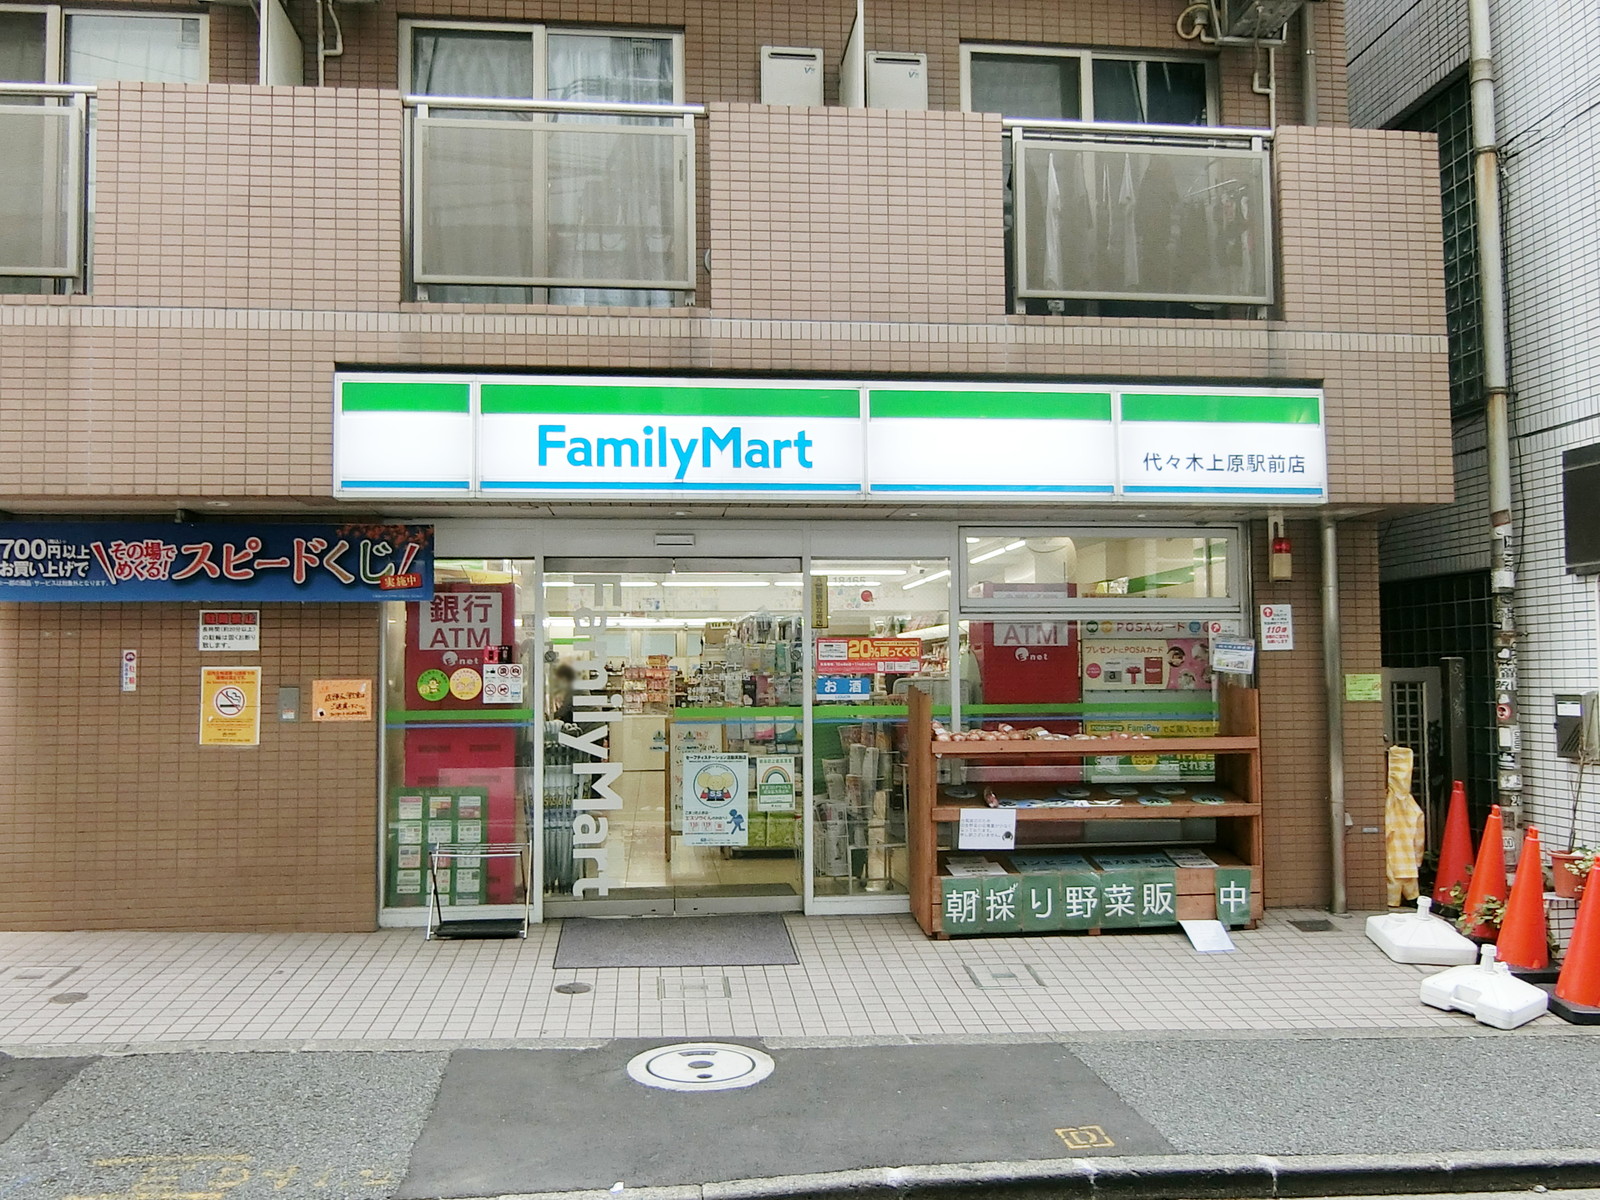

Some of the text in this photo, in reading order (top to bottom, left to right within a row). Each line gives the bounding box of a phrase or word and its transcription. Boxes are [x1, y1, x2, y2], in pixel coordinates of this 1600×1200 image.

[538, 424, 813, 480] FamilyMart
[1143, 451, 1306, 474] 代々木上原駅前店
[109, 540, 177, 561] その場で
[0, 560, 90, 578] お買い上げで
[114, 560, 170, 581] めくる!
[383, 575, 418, 588] 実施中
[430, 594, 493, 623] 銀行
[429, 627, 492, 649] ATM
[1003, 624, 1059, 645] ATM
[1116, 622, 1186, 633] POSAカード
[1085, 646, 1164, 654] プレゼントにPOSAカード
[824, 680, 862, 693] お酒
[558, 574, 624, 897] FamilyMart
[1127, 724, 1160, 733] FamiPay
[945, 880, 1247, 924] 朝採り野菜販 中
